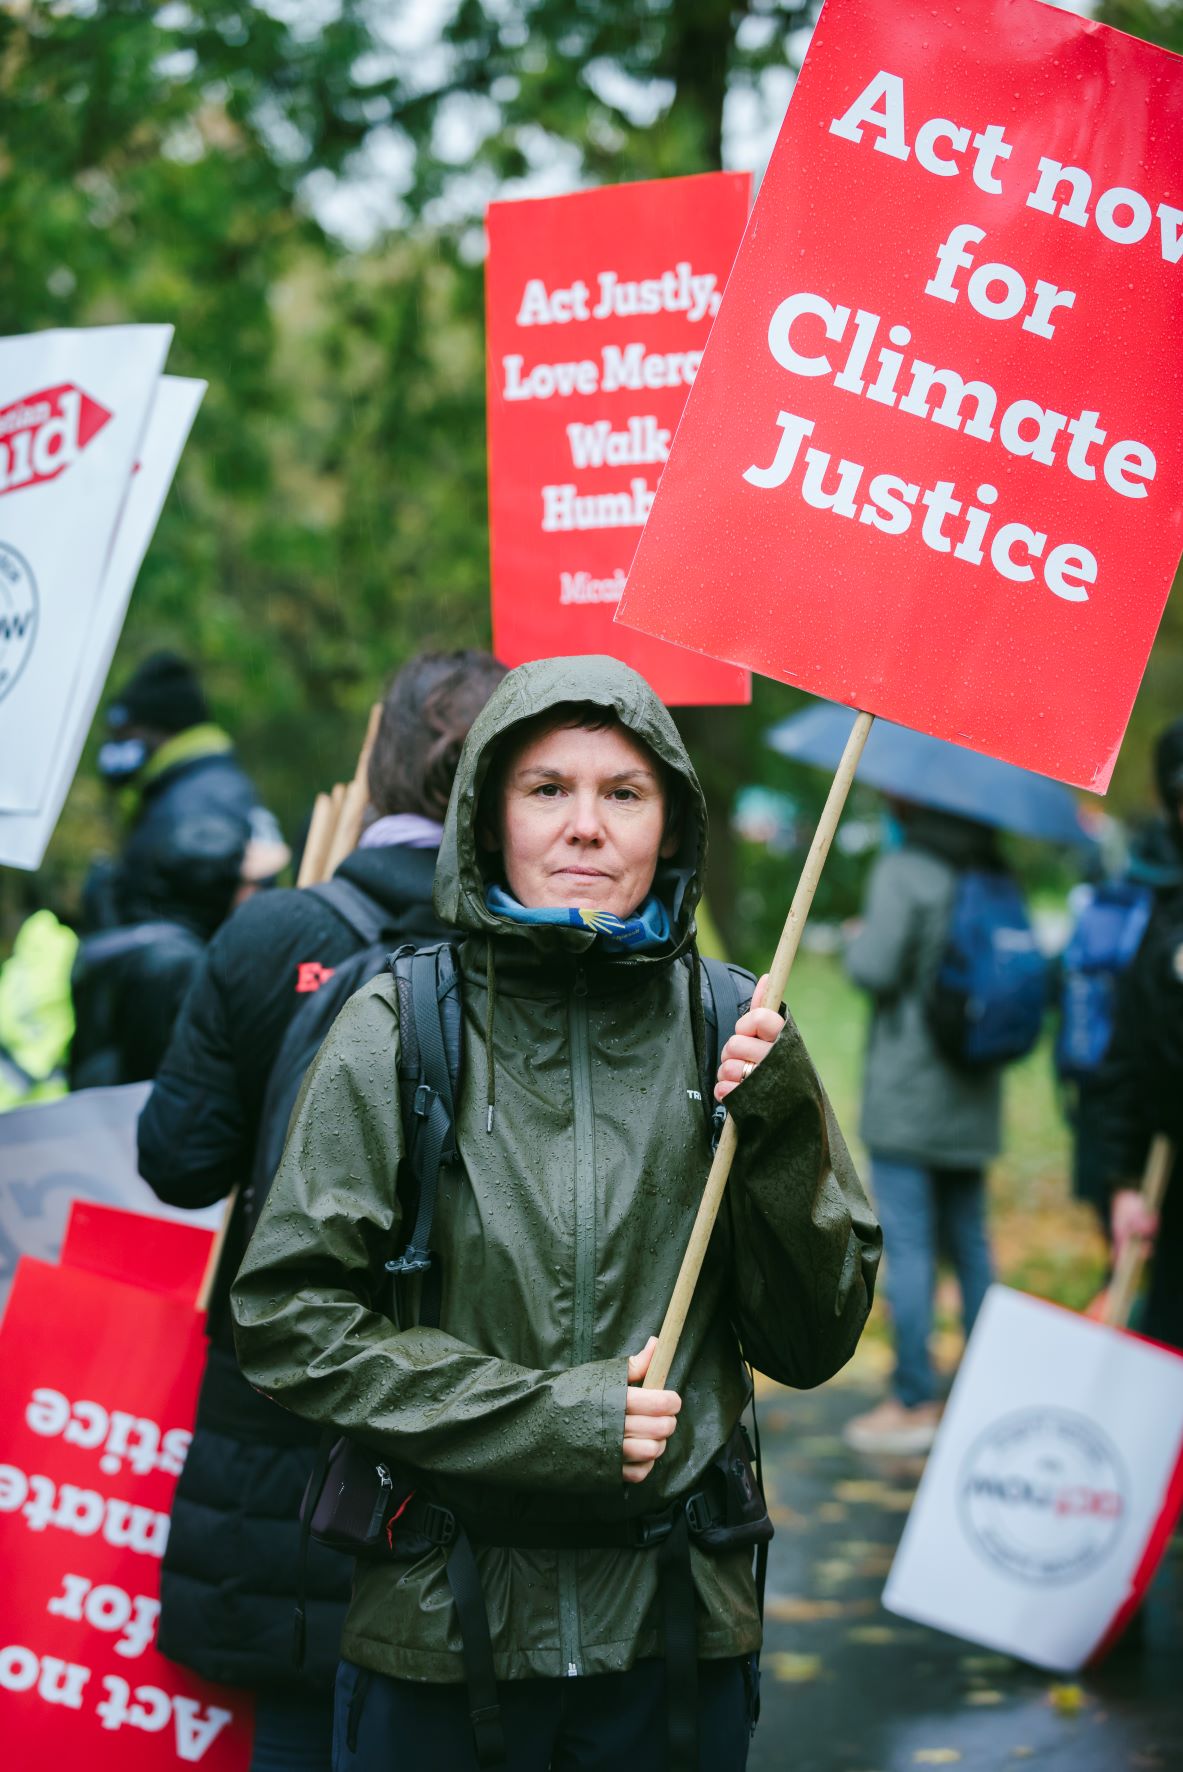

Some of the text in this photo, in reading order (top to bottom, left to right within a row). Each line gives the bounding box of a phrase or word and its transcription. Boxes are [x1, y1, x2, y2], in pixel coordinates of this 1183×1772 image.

[829, 70, 1013, 195] Act
[516, 262, 722, 327] Act Justly,
[925, 223, 1077, 340] for
[502, 343, 704, 401] Love Merc
[767, 292, 1157, 499] Climate
[566, 414, 671, 469] Walk
[541, 477, 657, 532] Humb
[741, 410, 1098, 602] Justice
[686, 1089, 702, 1101] TR
[25, 1387, 193, 1475] stice
[0, 1463, 171, 1557] mate
[47, 1573, 162, 1658] for
[0, 1645, 233, 1762] Act no
